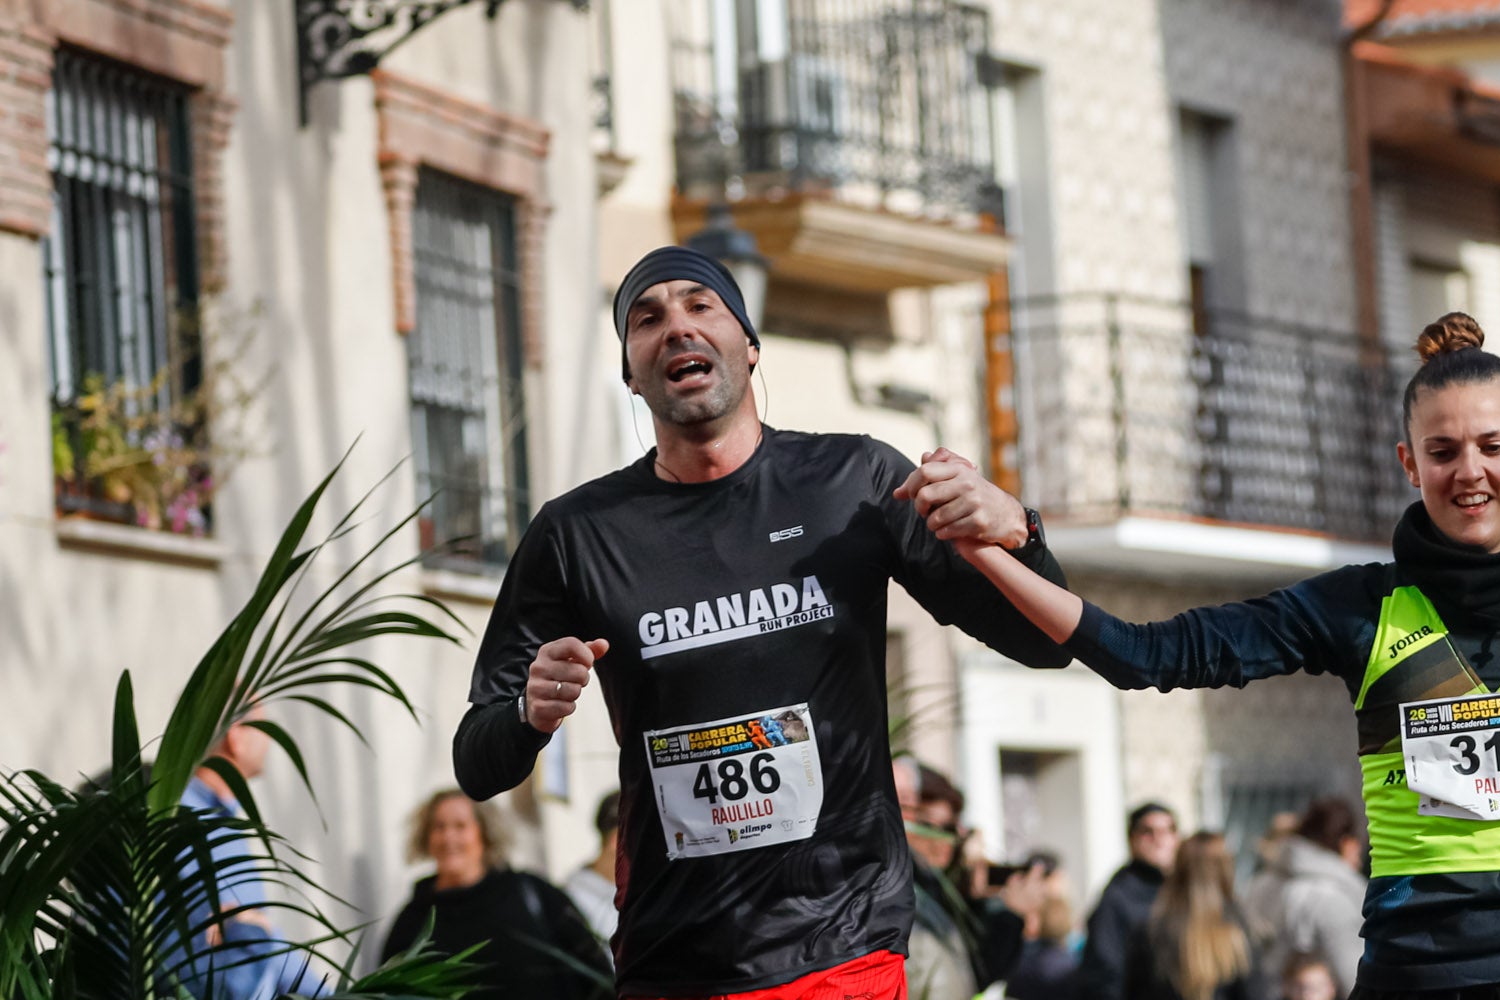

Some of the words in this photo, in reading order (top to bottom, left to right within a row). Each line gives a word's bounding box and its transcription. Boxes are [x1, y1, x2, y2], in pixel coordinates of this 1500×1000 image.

[638, 574, 829, 646] GRANADA
[760, 619, 782, 633] RUN
[786, 606, 833, 627] PROJECT
[1388, 625, 1433, 659] Joma
[1410, 708, 1426, 720] 26
[688, 724, 746, 742] CARRERA
[1411, 726, 1428, 735] Ruta
[1439, 723, 1450, 731] los
[1451, 720, 1489, 731] Secaderos
[690, 734, 747, 750] POPULAR
[693, 752, 781, 804] 486
[1383, 769, 1406, 786] AT
[712, 798, 773, 825] RAULILLO
[740, 823, 772, 835] olimpo
